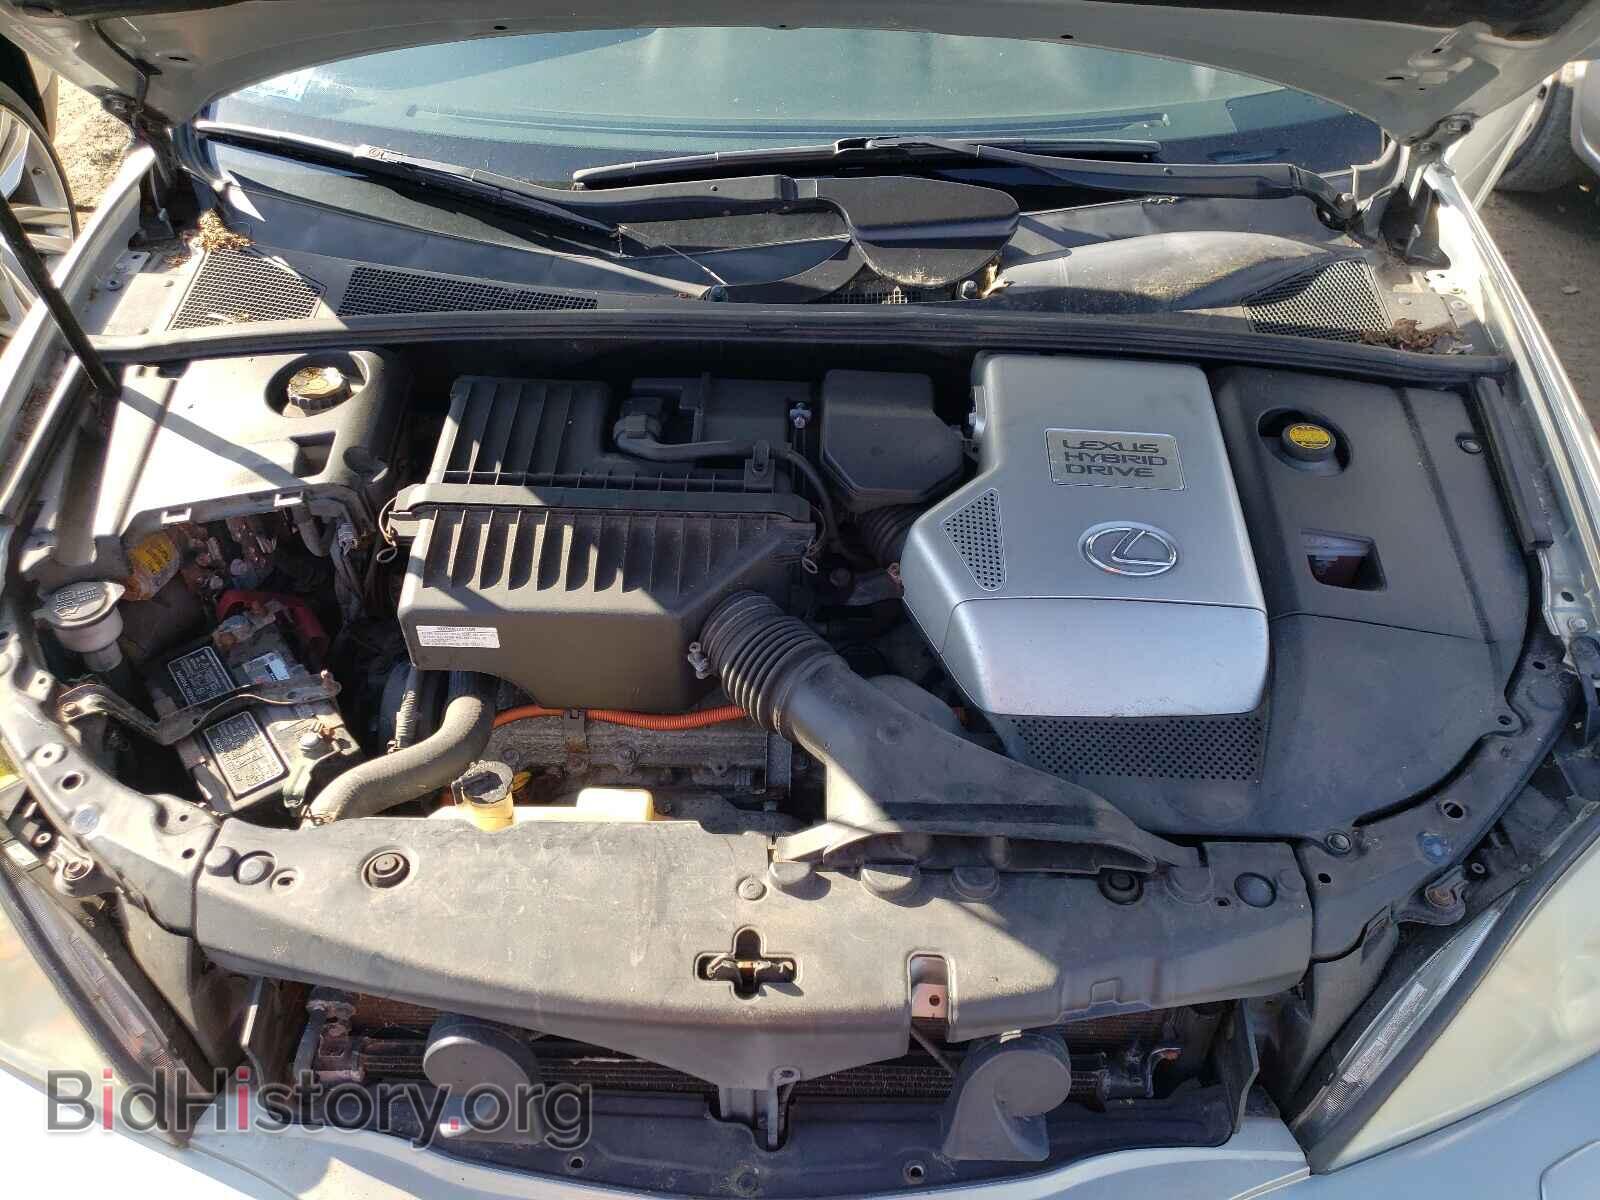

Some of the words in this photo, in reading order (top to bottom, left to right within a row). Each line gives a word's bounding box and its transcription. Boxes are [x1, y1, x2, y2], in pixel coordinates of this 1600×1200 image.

[1062, 439, 1160, 454] LEXUS
[1063, 451, 1168, 466] HYBRID
[1065, 463, 1155, 478] DRIVE
